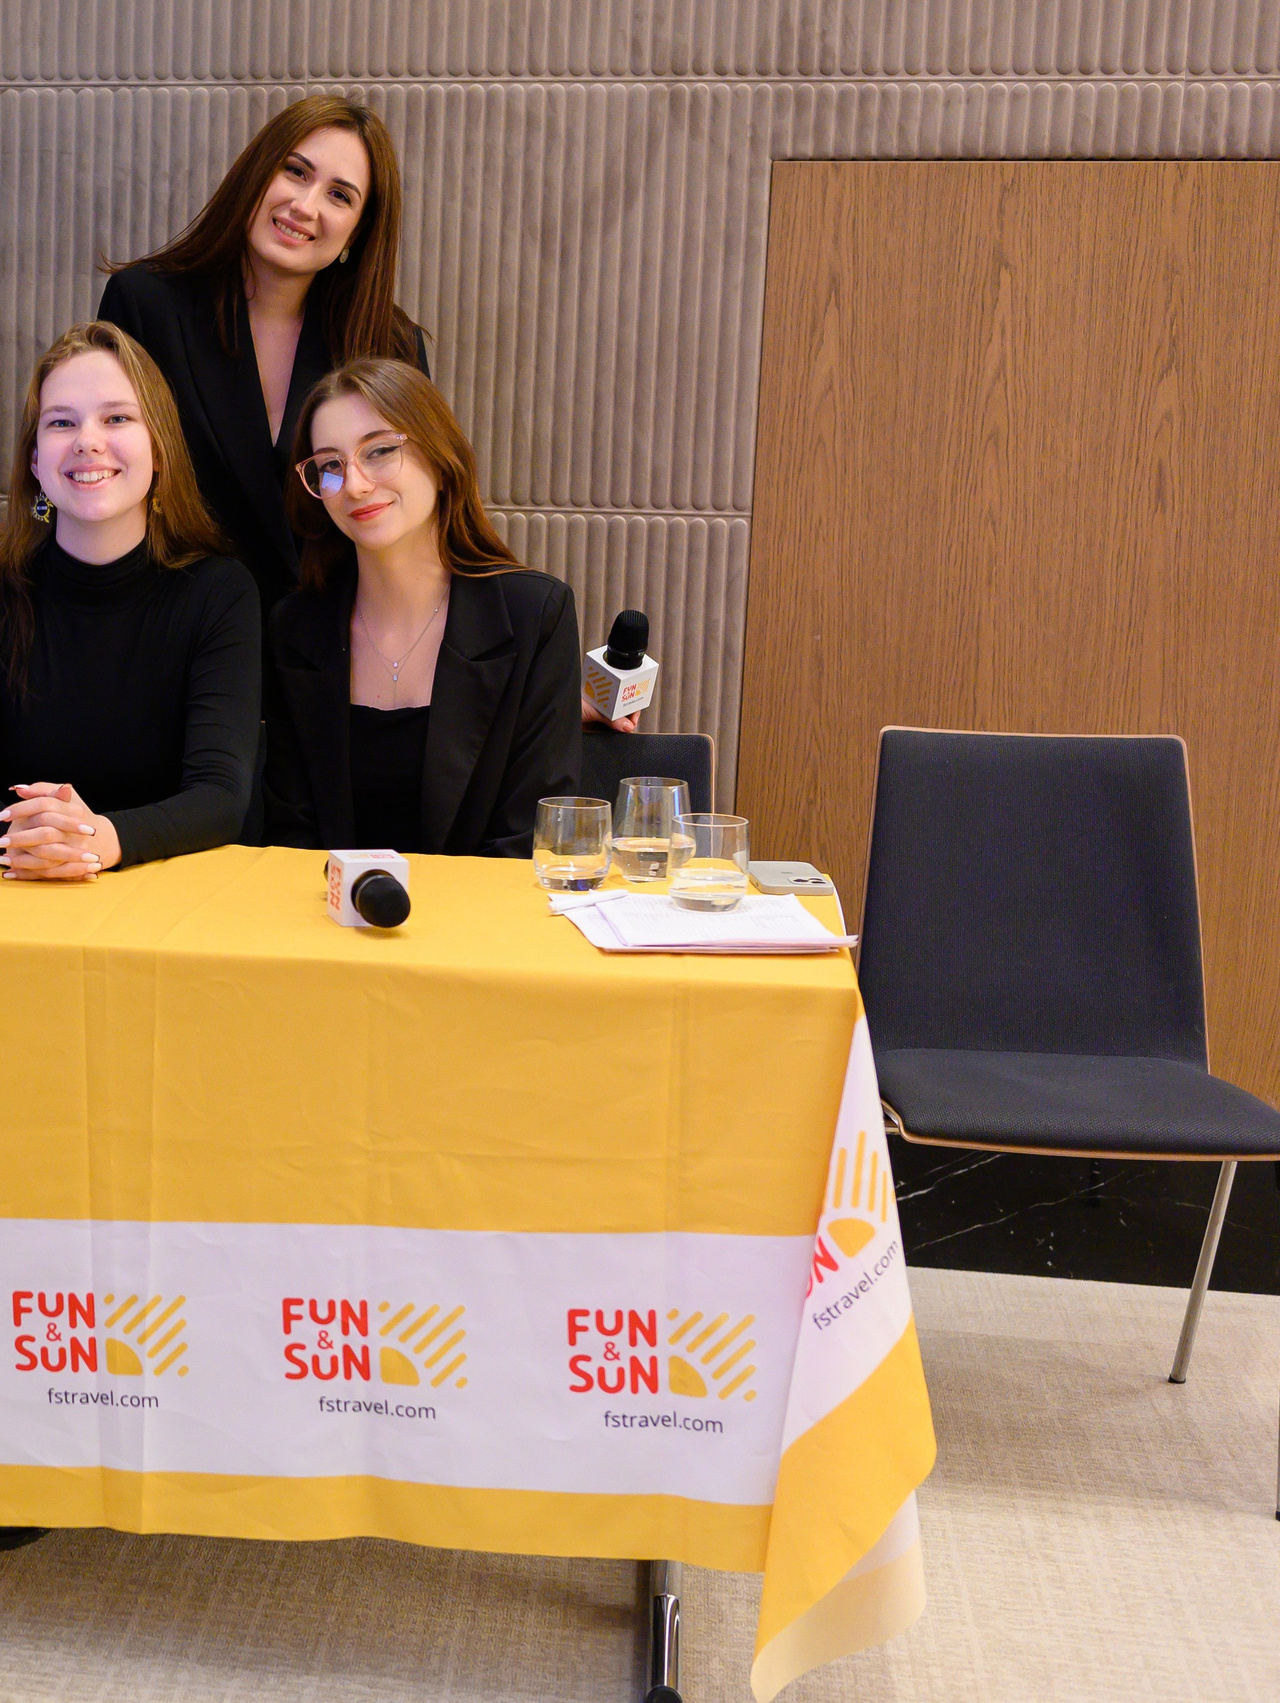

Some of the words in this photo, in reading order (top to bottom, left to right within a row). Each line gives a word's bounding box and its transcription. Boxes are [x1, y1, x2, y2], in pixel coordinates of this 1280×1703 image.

[812, 1240, 898, 1331] fstravel.com
[12, 1291, 95, 1329] FUN
[282, 1297, 368, 1337] FUN
[567, 1309, 657, 1347] FUN
[46, 1322, 62, 1342] &
[317, 1330, 333, 1350] &
[603, 1341, 620, 1361] &
[14, 1334, 98, 1373] SUN
[284, 1342, 371, 1381] SUN
[568, 1354, 659, 1395] SUN
[48, 1387, 159, 1408] fstravel.com
[319, 1396, 436, 1419] fstravel.com
[604, 1410, 724, 1434] fstravel.com
